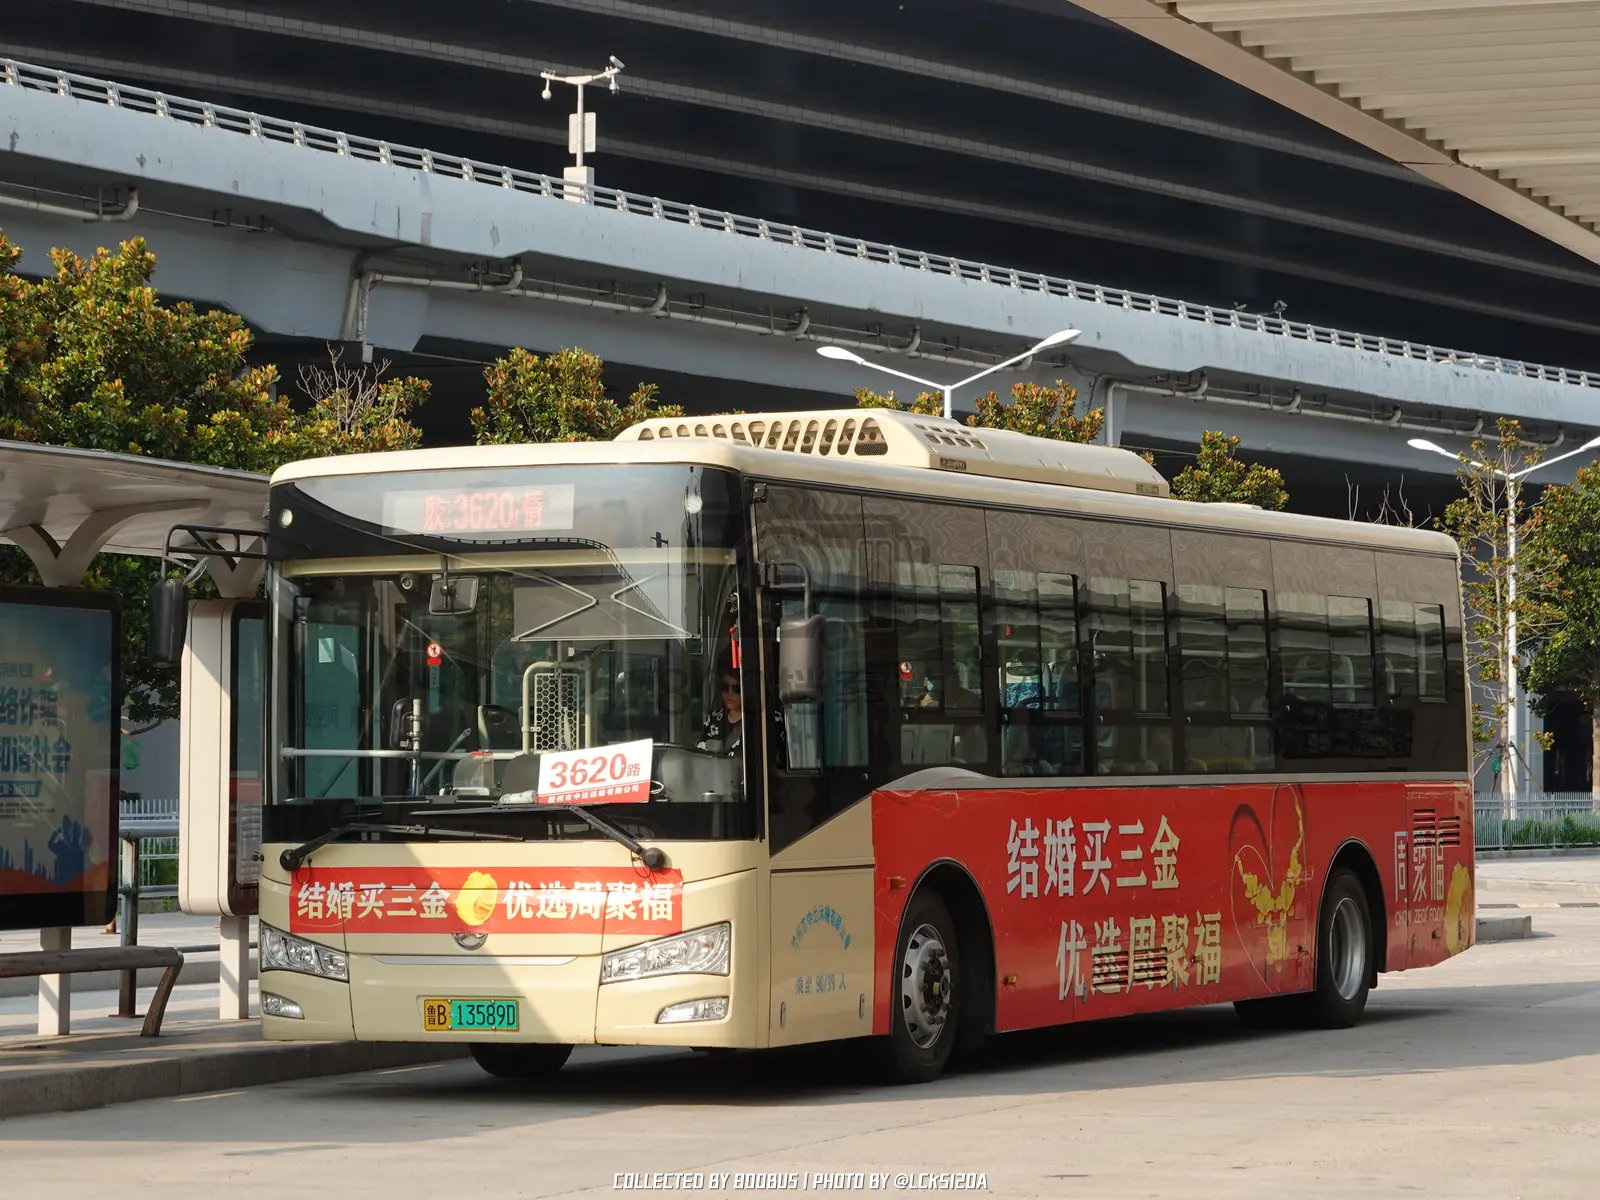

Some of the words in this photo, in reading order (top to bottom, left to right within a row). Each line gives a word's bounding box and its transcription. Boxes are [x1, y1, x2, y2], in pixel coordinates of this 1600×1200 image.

[549, 753, 640, 789] 3620路
[1006, 814, 1180, 899] 结婚买三金
[297, 880, 450, 919] 结婚买三金
[502, 880, 673, 921] 优选周聚福
[1055, 911, 1222, 1001] 优选周聚福
